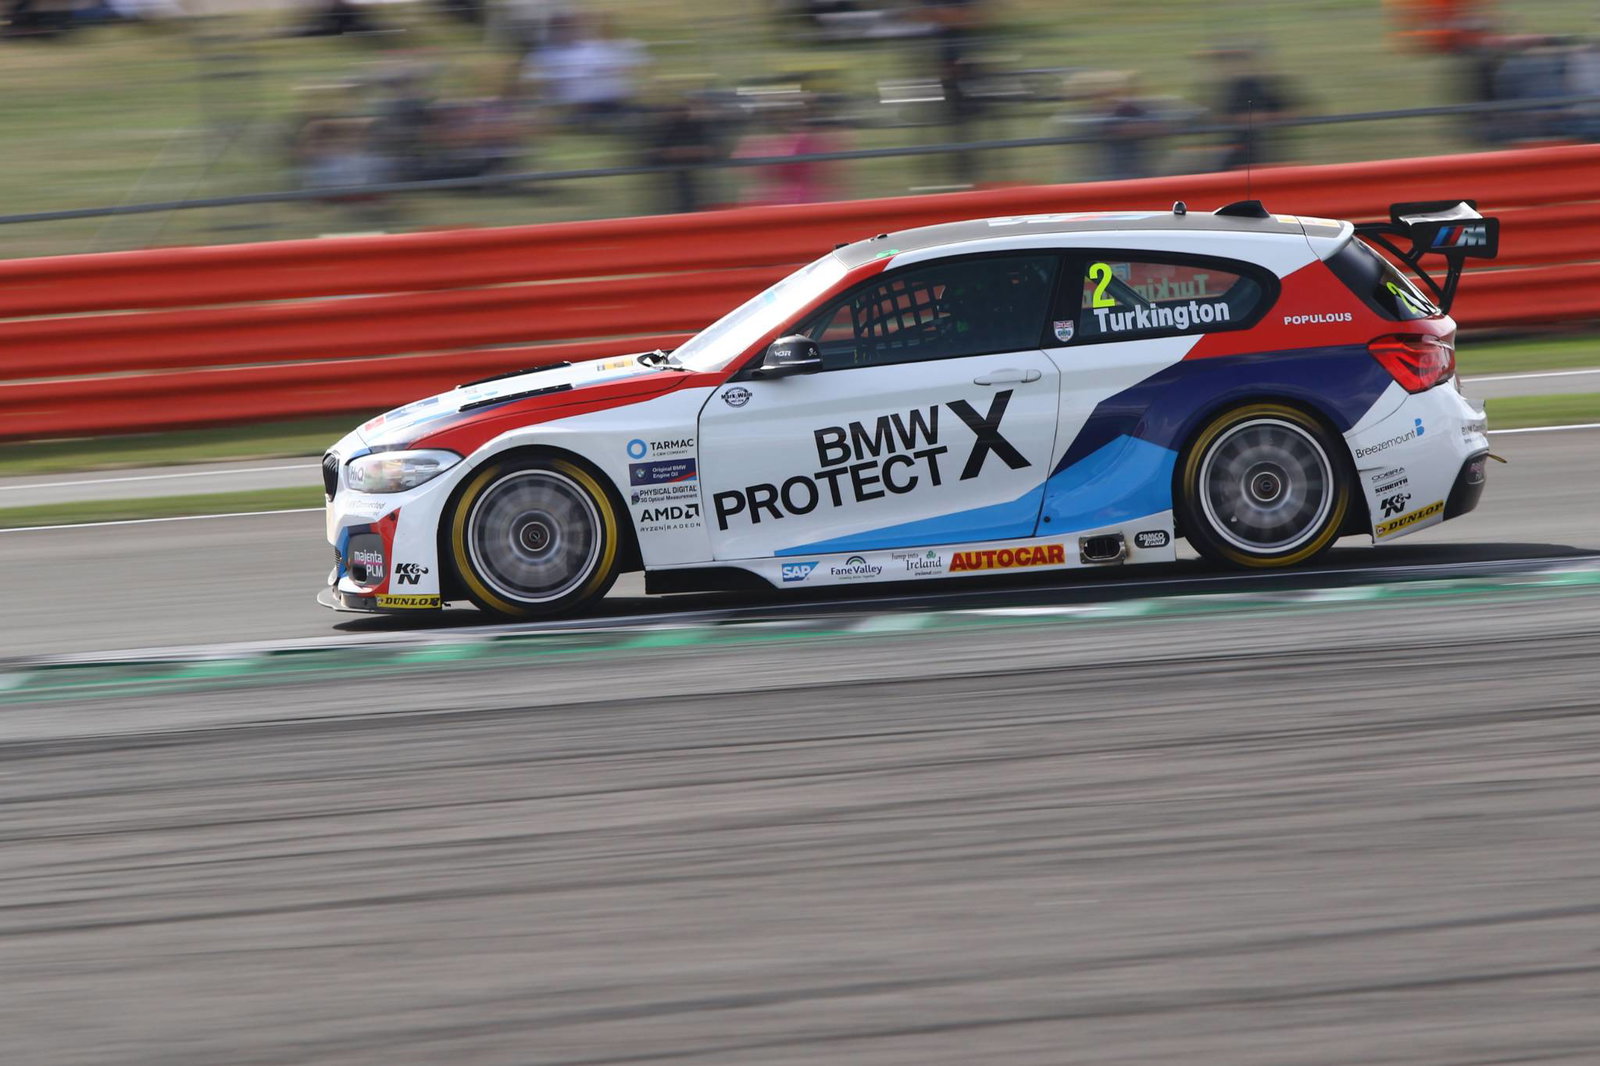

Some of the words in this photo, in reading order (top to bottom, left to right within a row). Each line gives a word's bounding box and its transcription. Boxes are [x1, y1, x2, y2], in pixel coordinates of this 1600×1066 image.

[1088, 262, 1116, 309] 2
[1386, 281, 1418, 313] 2
[1093, 299, 1231, 333] Turkington
[1283, 312, 1353, 325] POPULOUS
[813, 404, 940, 468] BMW
[945, 388, 1032, 481] X
[650, 438, 694, 451] TARMAC
[1355, 430, 1416, 459] Breezemount
[652, 466, 672, 474] Original
[639, 487, 671, 497] PHYSICAL
[672, 485, 697, 494] DIGITAL
[712, 445, 948, 531] PROTECT
[666, 493, 697, 502] Measurement
[640, 506, 684, 523] AMD
[1388, 502, 1444, 532] DUNLOP
[354, 549, 383, 565] majenta
[906, 556, 942, 571] Ireland
[948, 544, 1065, 573] AUTOCAR
[366, 565, 384, 579] PLM
[782, 565, 811, 579] SAP
[385, 596, 440, 607] DUNLOP
